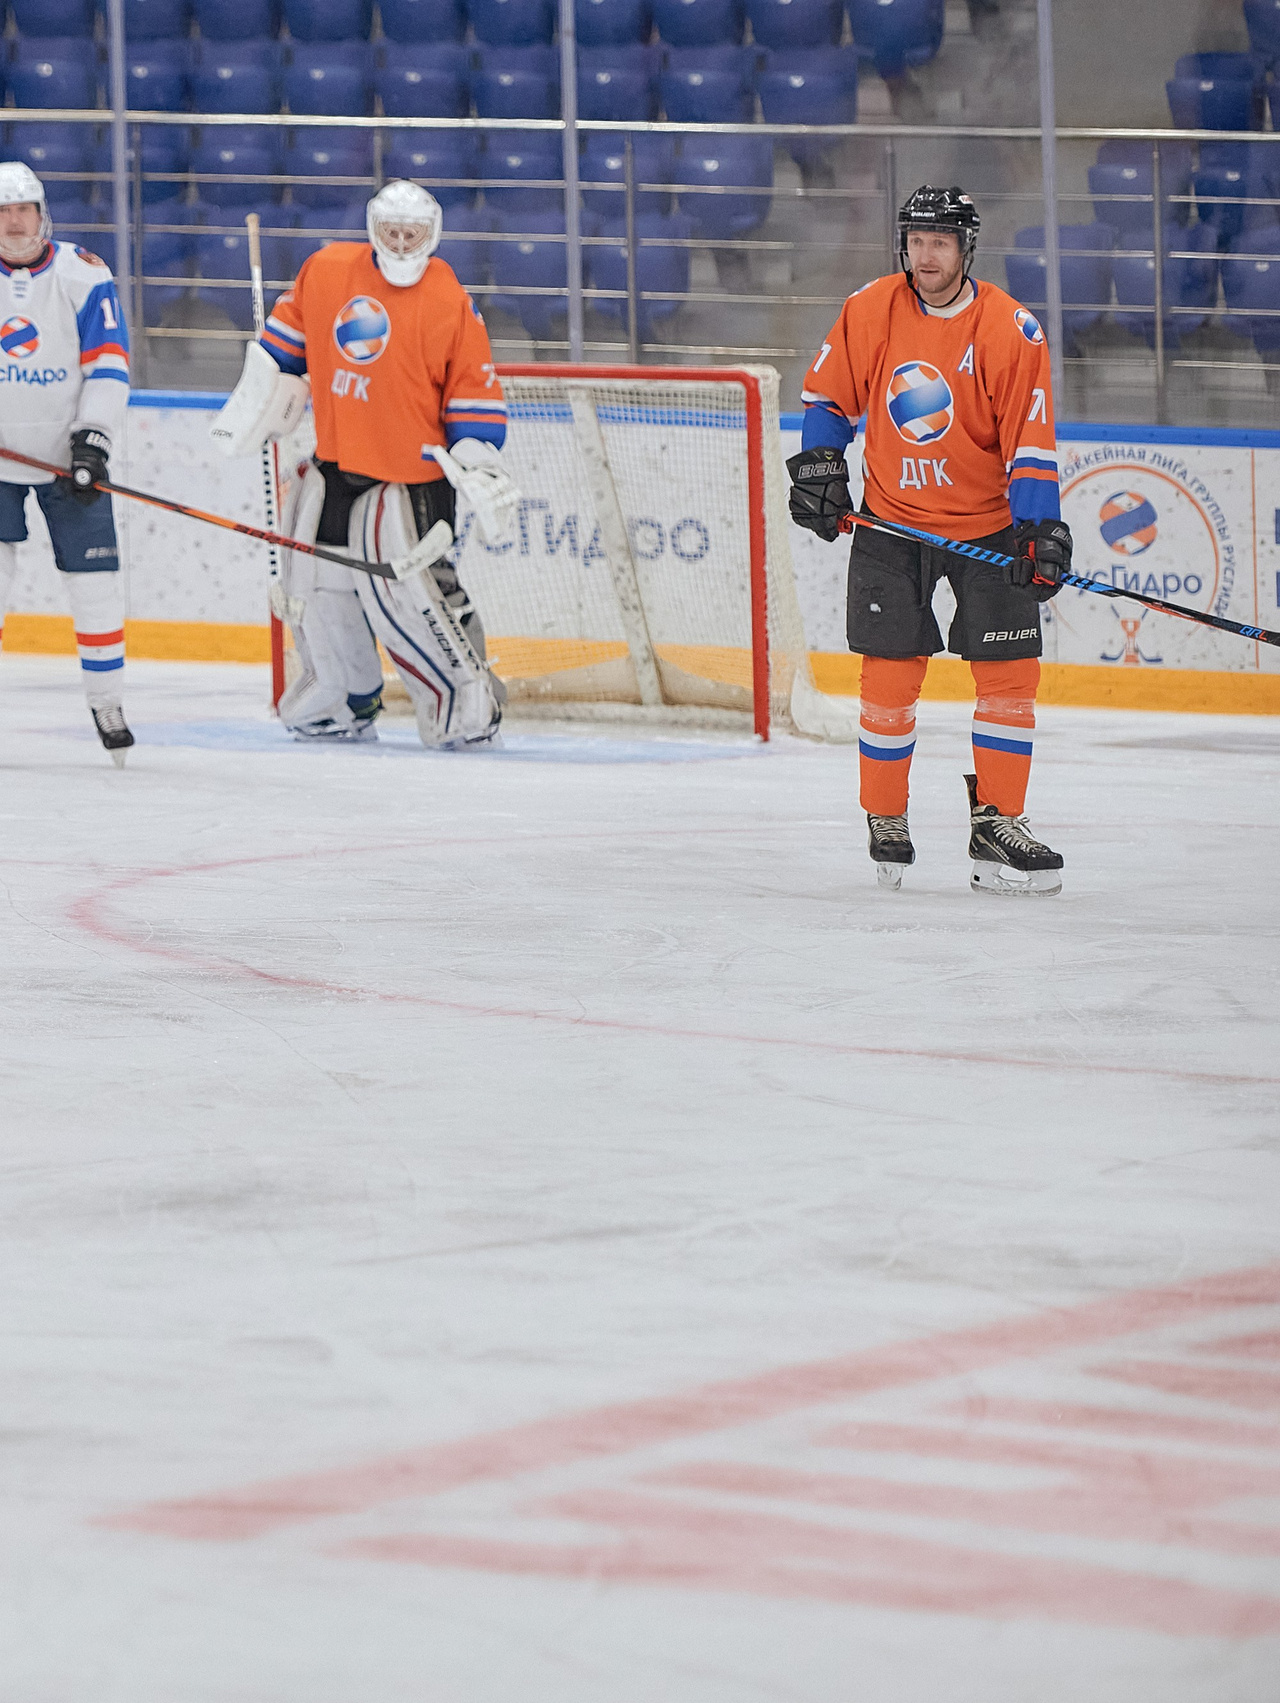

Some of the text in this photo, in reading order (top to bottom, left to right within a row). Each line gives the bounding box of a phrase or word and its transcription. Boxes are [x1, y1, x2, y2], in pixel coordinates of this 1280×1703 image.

[957, 343, 974, 376] A
[331, 368, 371, 403] ДГК
[898, 457, 954, 490] ДГК
[1149, 452, 1187, 481] ЛИГА
[1187, 476, 1232, 540] ГРУППЫ
[1072, 564, 1204, 599] усГидро
[982, 628, 1039, 643] BAUER
[1239, 624, 1268, 642] QRL
